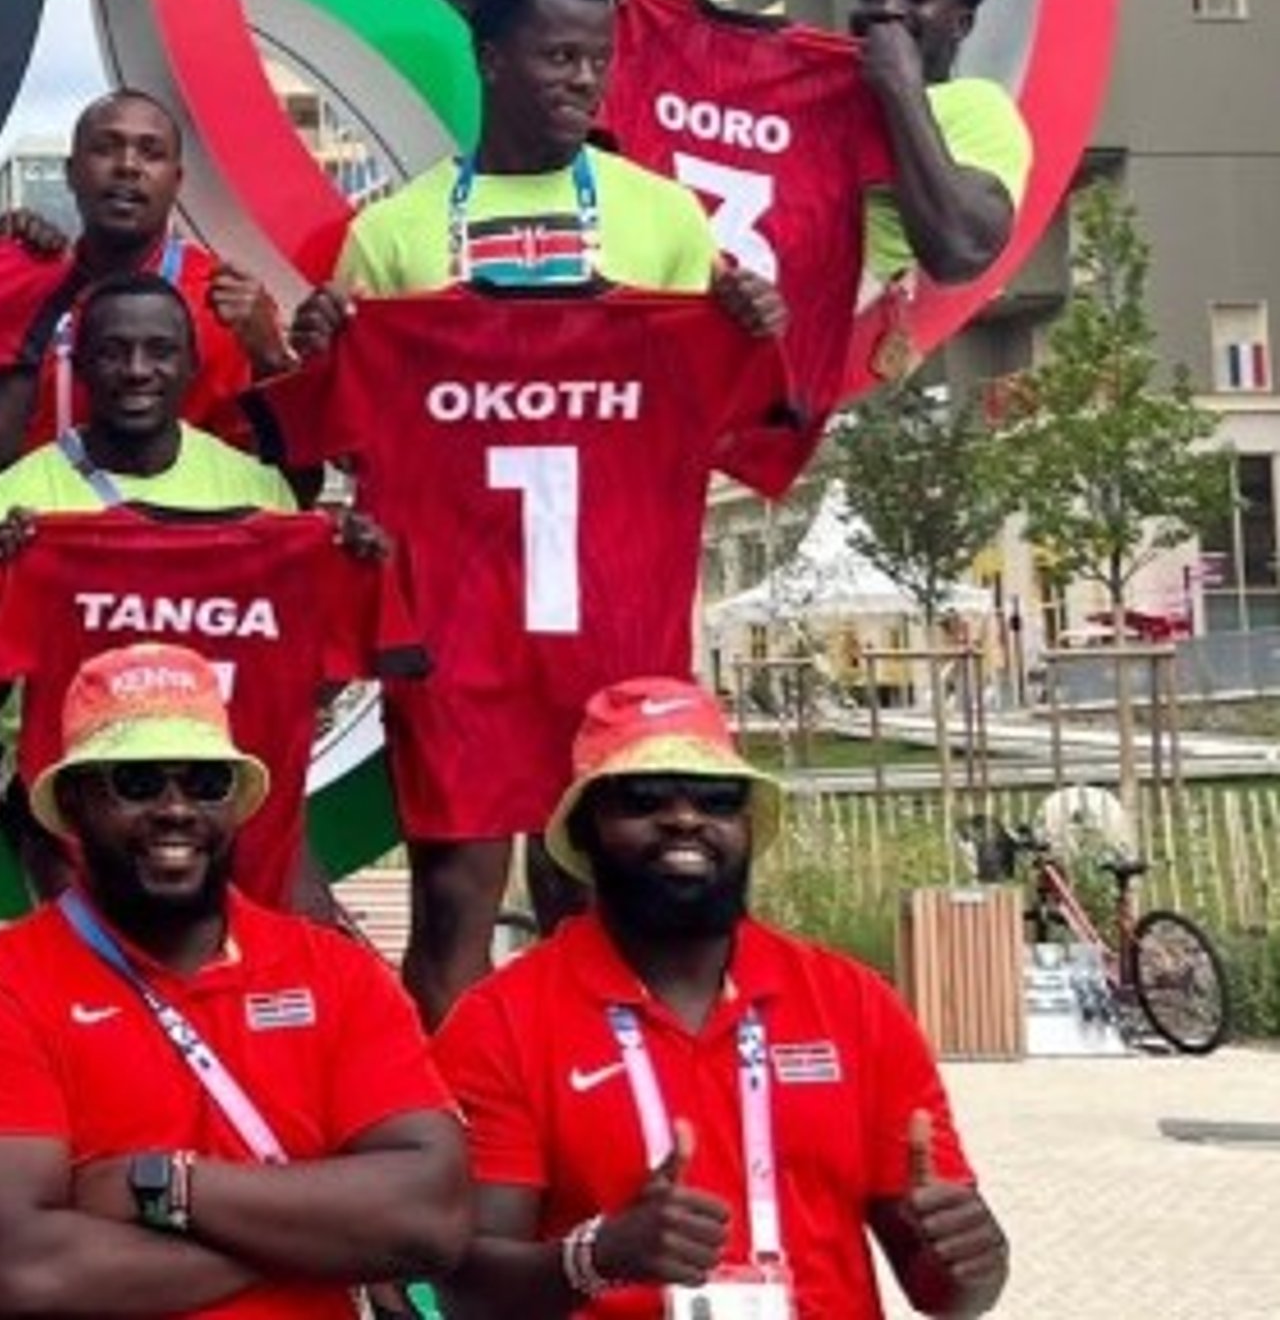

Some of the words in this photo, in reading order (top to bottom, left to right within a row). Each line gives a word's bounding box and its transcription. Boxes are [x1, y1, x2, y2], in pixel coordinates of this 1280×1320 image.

[655, 93, 791, 154] OORO
[672, 151, 777, 281] 3
[427, 381, 641, 421] OKOTH
[485, 445, 581, 633] 1
[76, 592, 280, 638] TANGA
